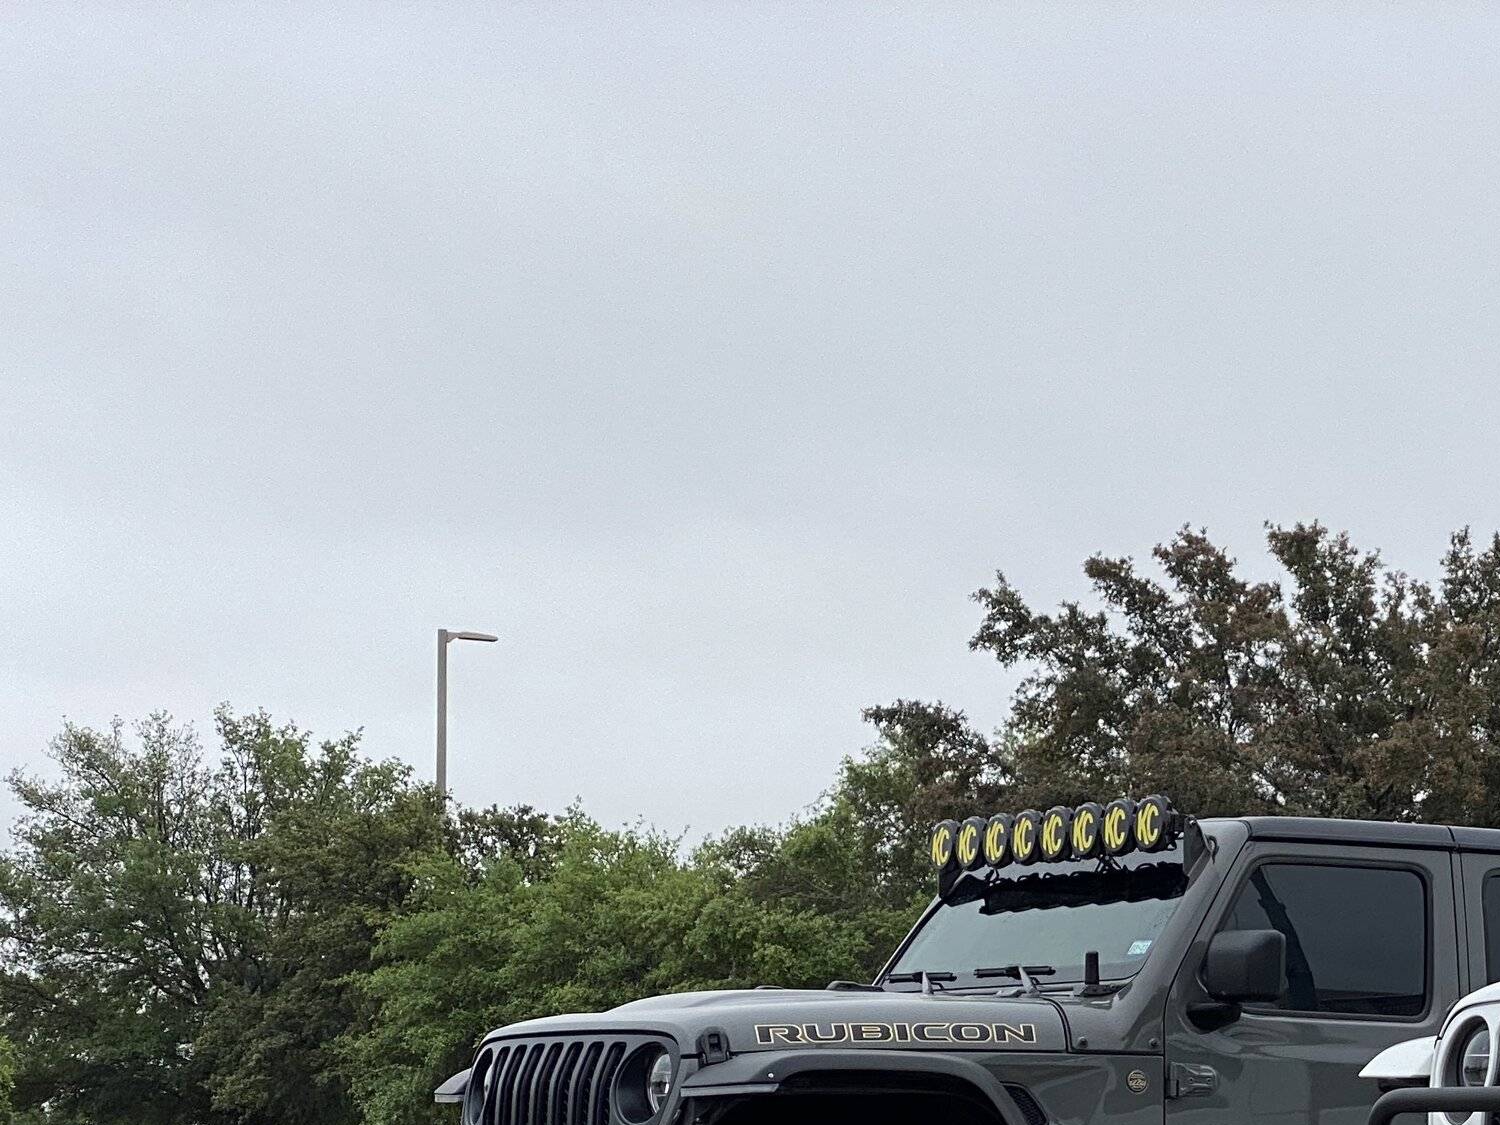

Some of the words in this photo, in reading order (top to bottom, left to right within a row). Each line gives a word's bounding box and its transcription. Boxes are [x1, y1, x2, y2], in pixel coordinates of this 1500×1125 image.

[958, 824, 977, 863] KC
[986, 821, 1004, 861] KC
[1013, 817, 1032, 858] KC
[1043, 813, 1062, 855] KC
[1072, 810, 1094, 851] KC
[1104, 807, 1126, 849] KC
[1136, 802, 1159, 846] KC
[931, 827, 949, 866] KC
[754, 1022, 1037, 1044] RUBICON
